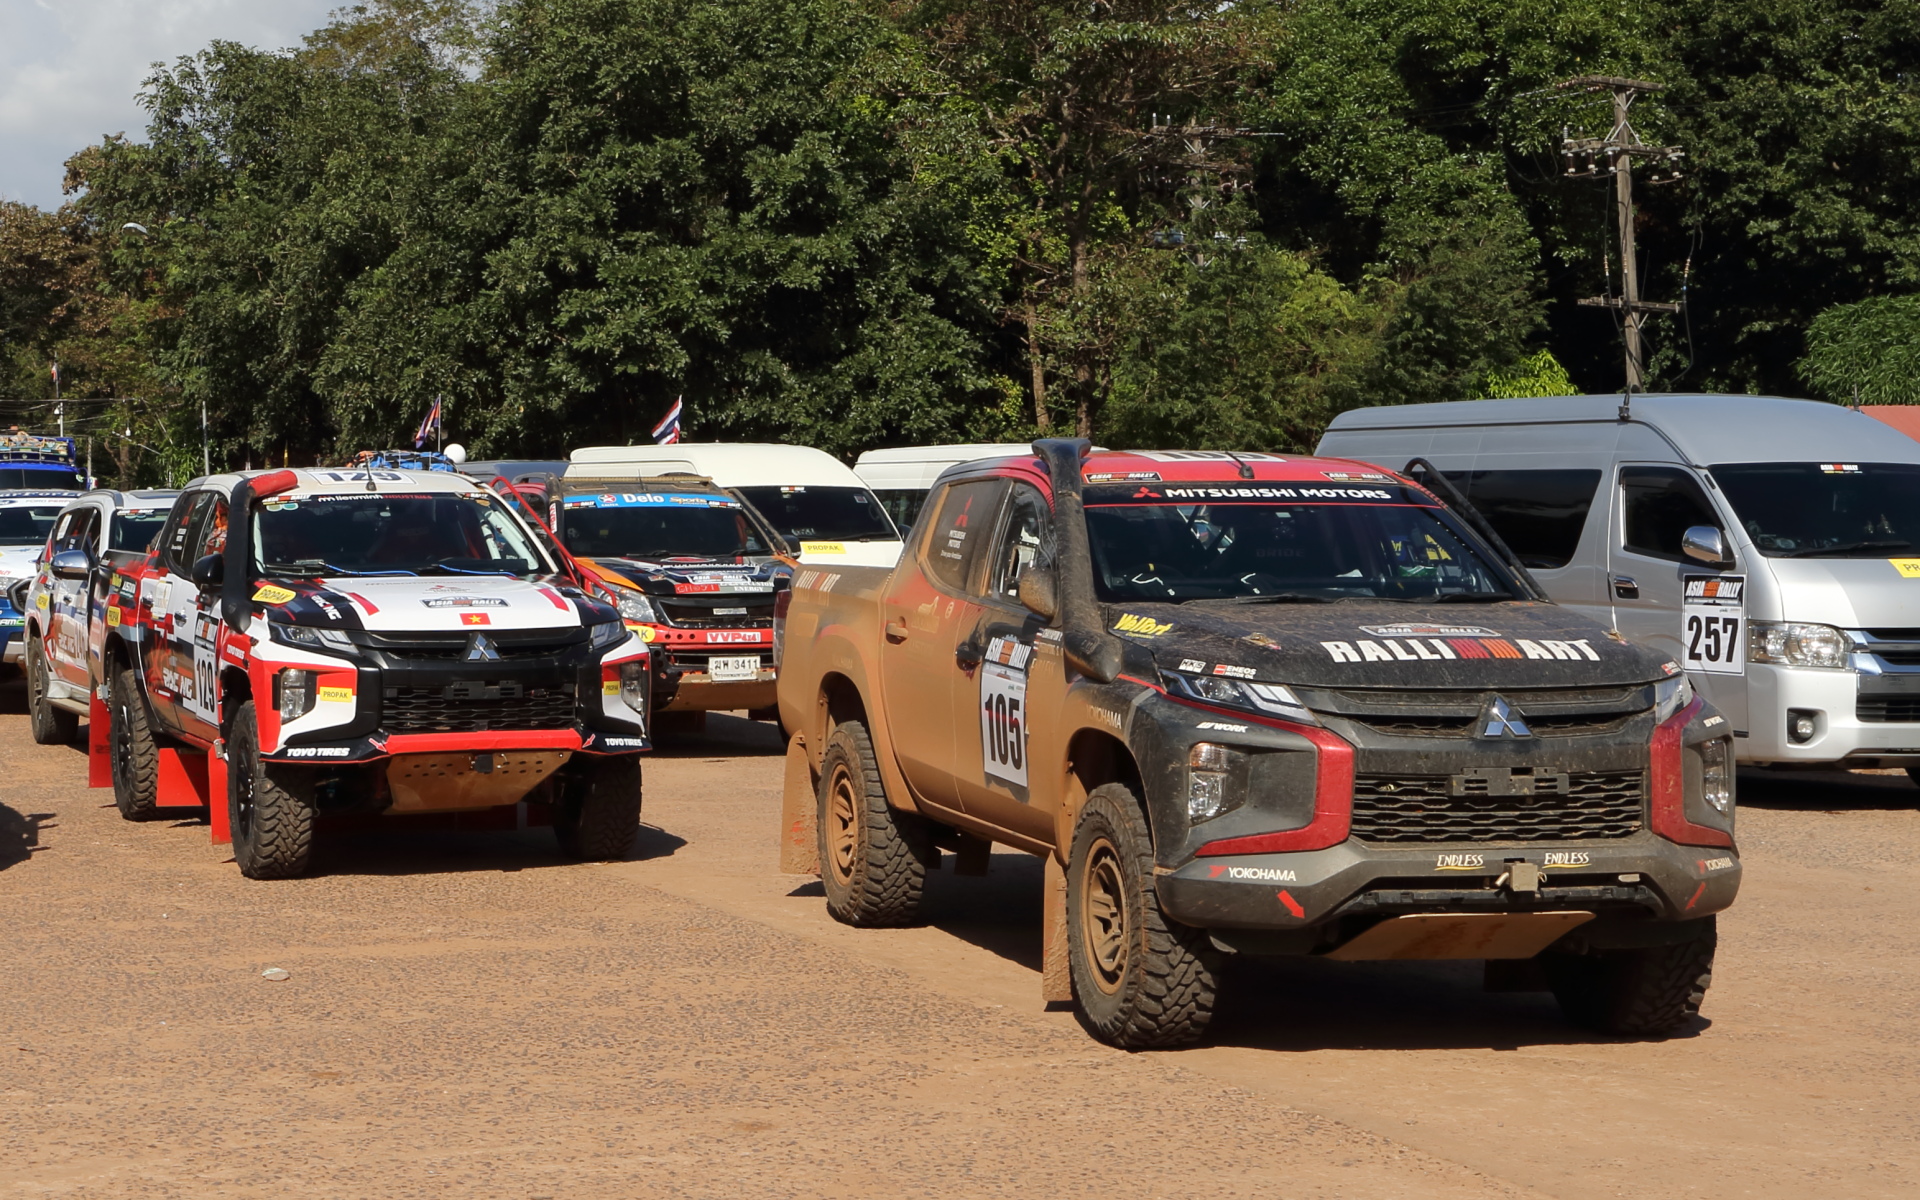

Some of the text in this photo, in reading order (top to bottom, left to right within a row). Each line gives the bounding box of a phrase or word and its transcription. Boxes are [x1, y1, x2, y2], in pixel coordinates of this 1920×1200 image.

[319, 472, 402, 482] 129
[622, 493, 665, 503] Delo
[1165, 488, 1393, 499] MITSUBISHI MOTORS
[1685, 581, 1706, 597] ASIA
[1716, 582, 1743, 598] RALLY
[1687, 615, 1739, 663] 257
[1319, 638, 1600, 663] RALLI ART
[734, 658, 758, 670] 3411
[1226, 665, 1257, 676] ENEOS
[196, 658, 215, 713] 129
[323, 691, 349, 699] PROPAK
[985, 693, 1022, 771] 105
[1213, 722, 1249, 733] WORK
[604, 738, 643, 747] TOYO TIRES
[287, 747, 351, 757] TOYO TIRES
[1437, 852, 1590, 867] ENDLESS ENDLESS
[1228, 866, 1297, 882] YOKOHAMA
